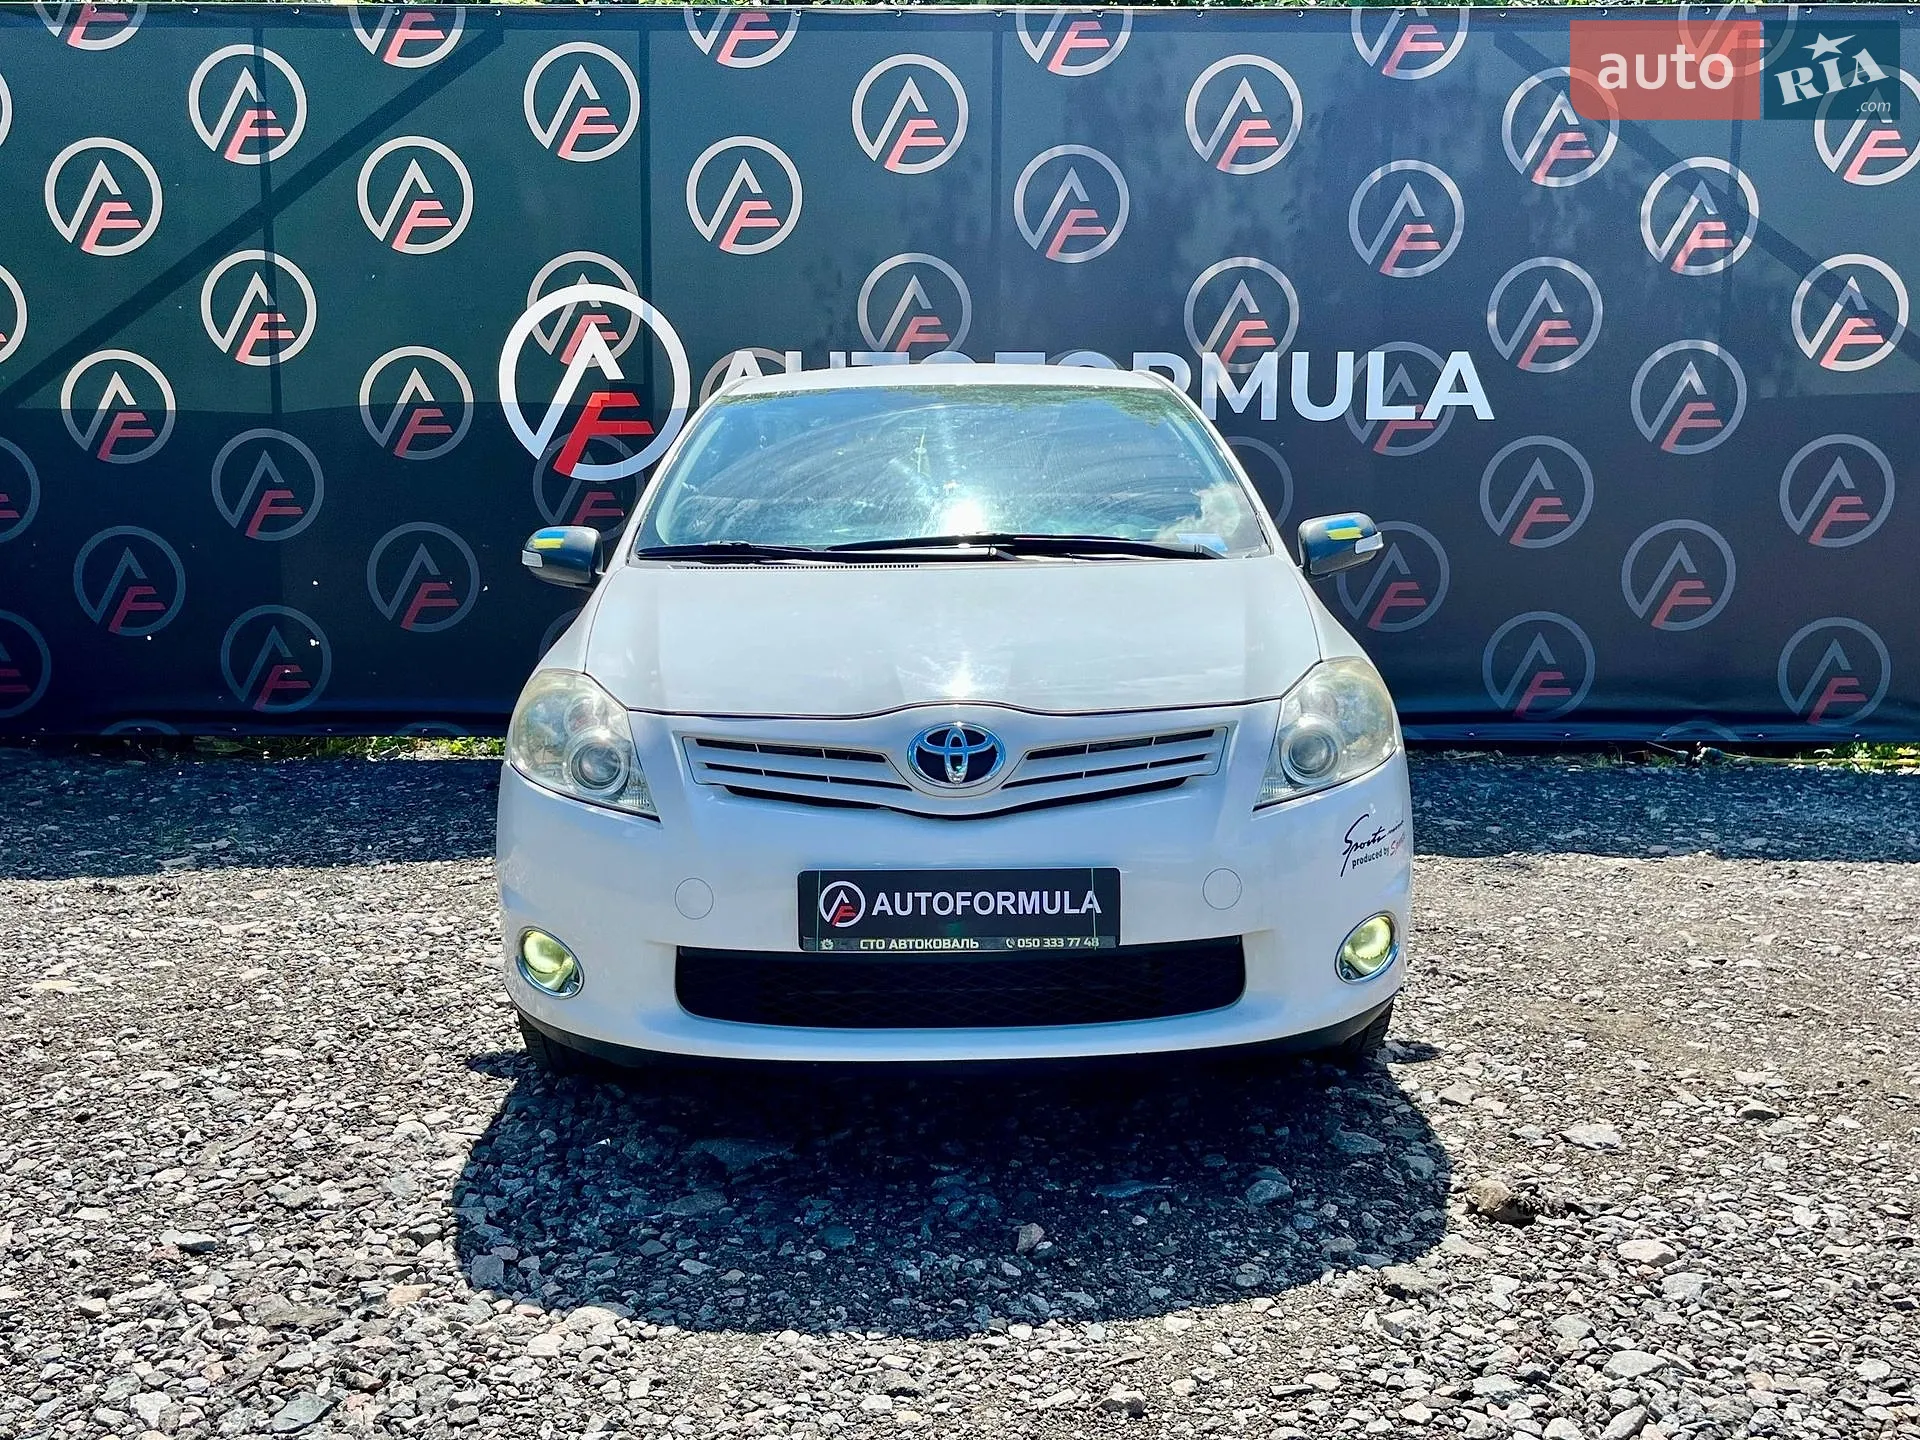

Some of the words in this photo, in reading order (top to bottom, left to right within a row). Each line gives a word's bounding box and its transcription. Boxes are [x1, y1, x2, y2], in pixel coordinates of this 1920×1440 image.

[1351, 848, 1383, 869] produced
[871, 890, 1102, 916] AUTOFORMULA
[859, 938, 886, 950] СТО
[888, 937, 980, 950] АВТОКОВАЛЬ
[1017, 938, 1040, 948] 050
[1043, 937, 1065, 948] 333
[1066, 937, 1081, 947] 77
